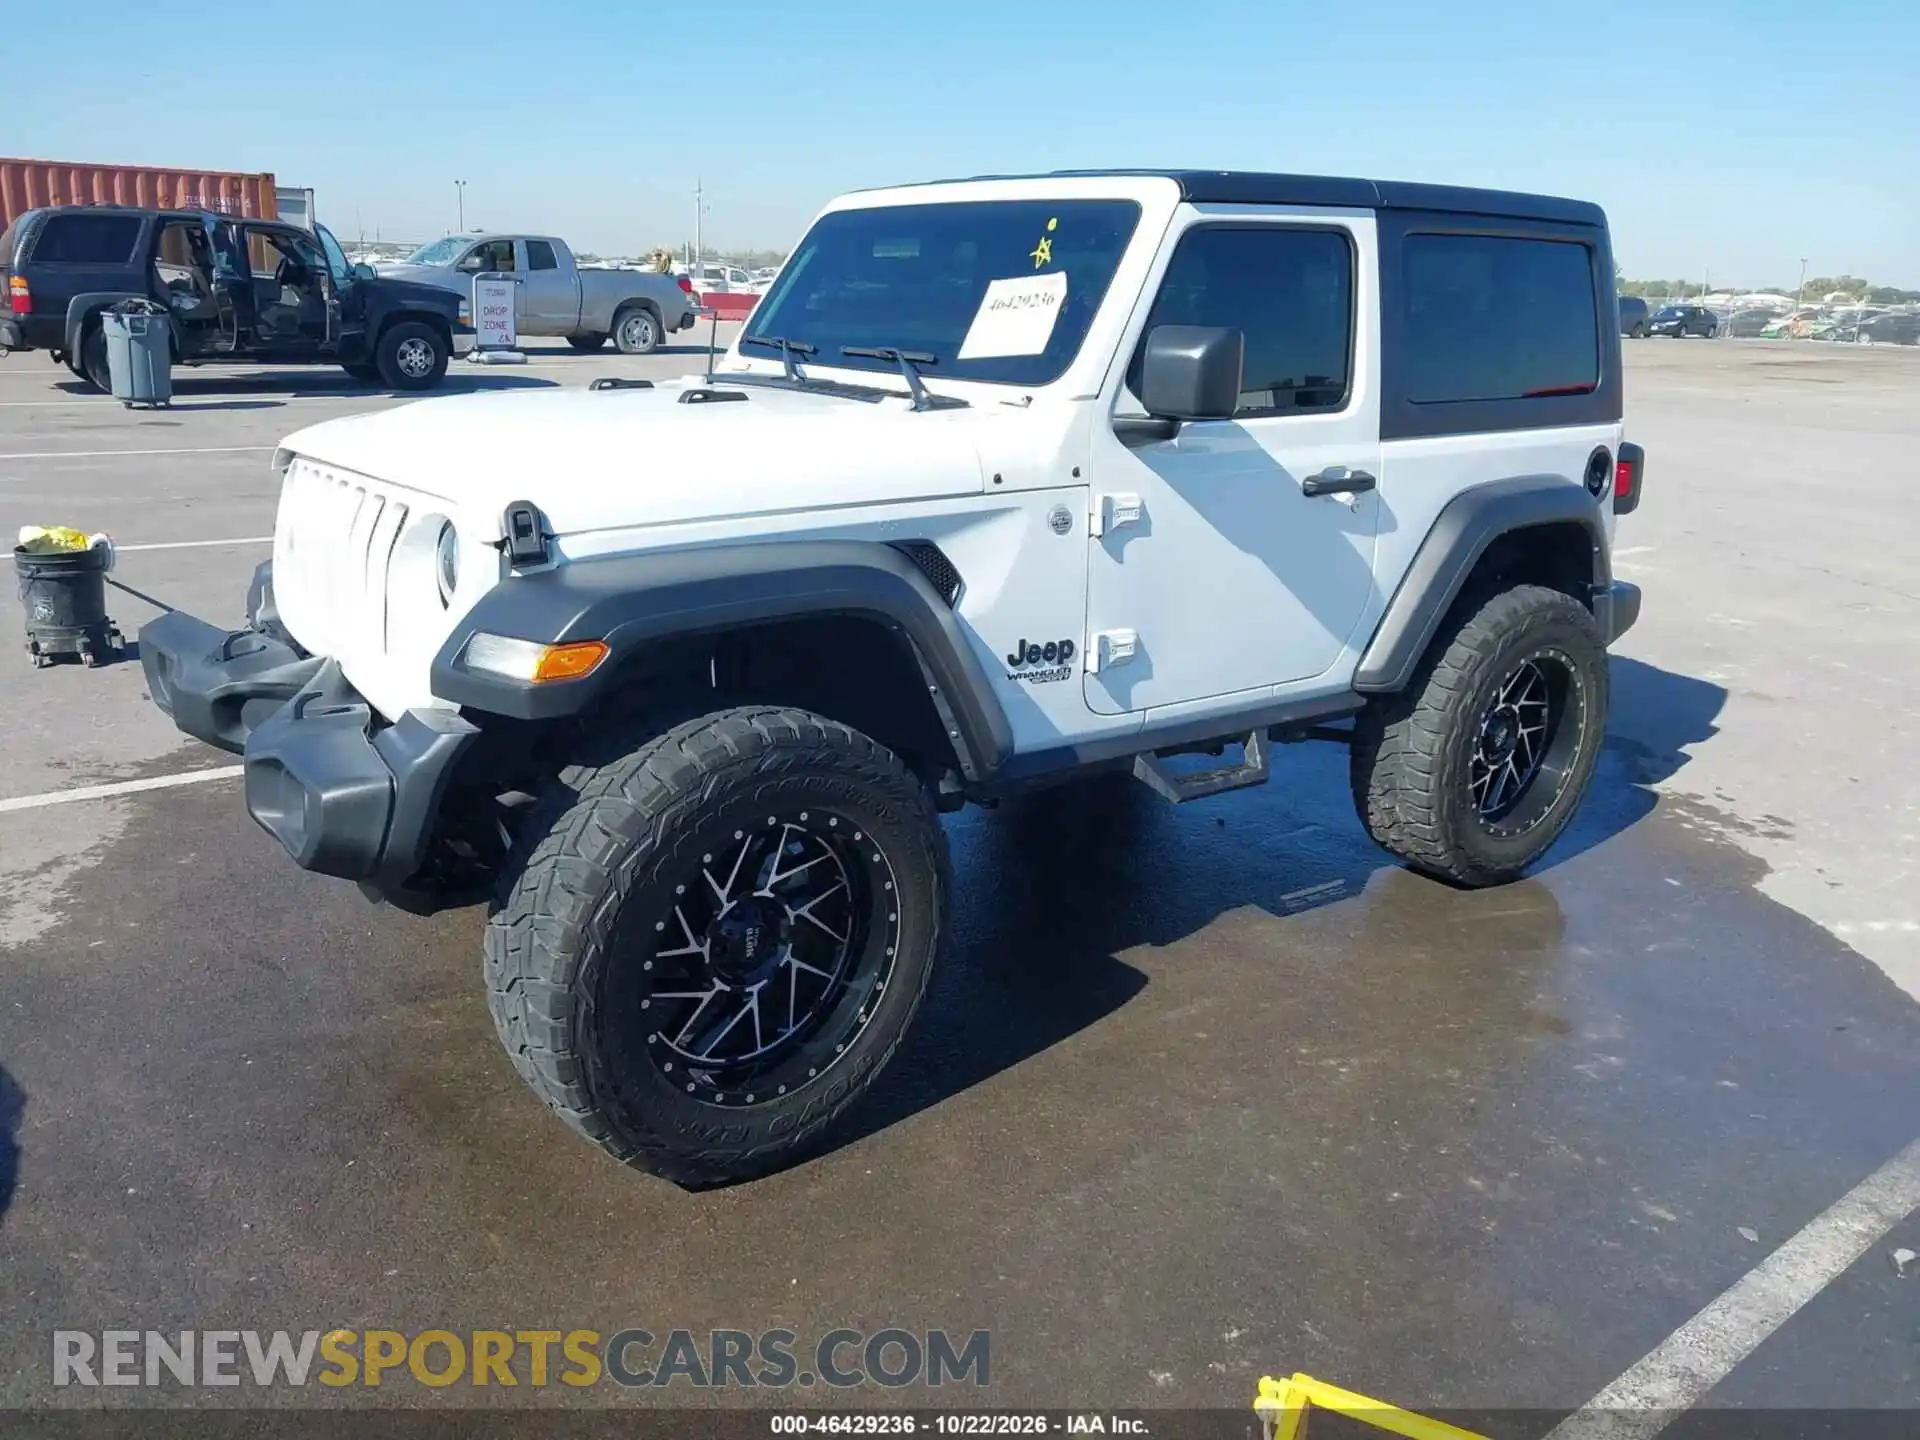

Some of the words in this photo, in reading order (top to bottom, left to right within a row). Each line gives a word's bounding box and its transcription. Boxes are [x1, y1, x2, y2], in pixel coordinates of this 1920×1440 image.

[484, 306, 508, 317] DROP
[484, 320, 508, 330] ZONE
[1007, 638, 1074, 667] Jeep
